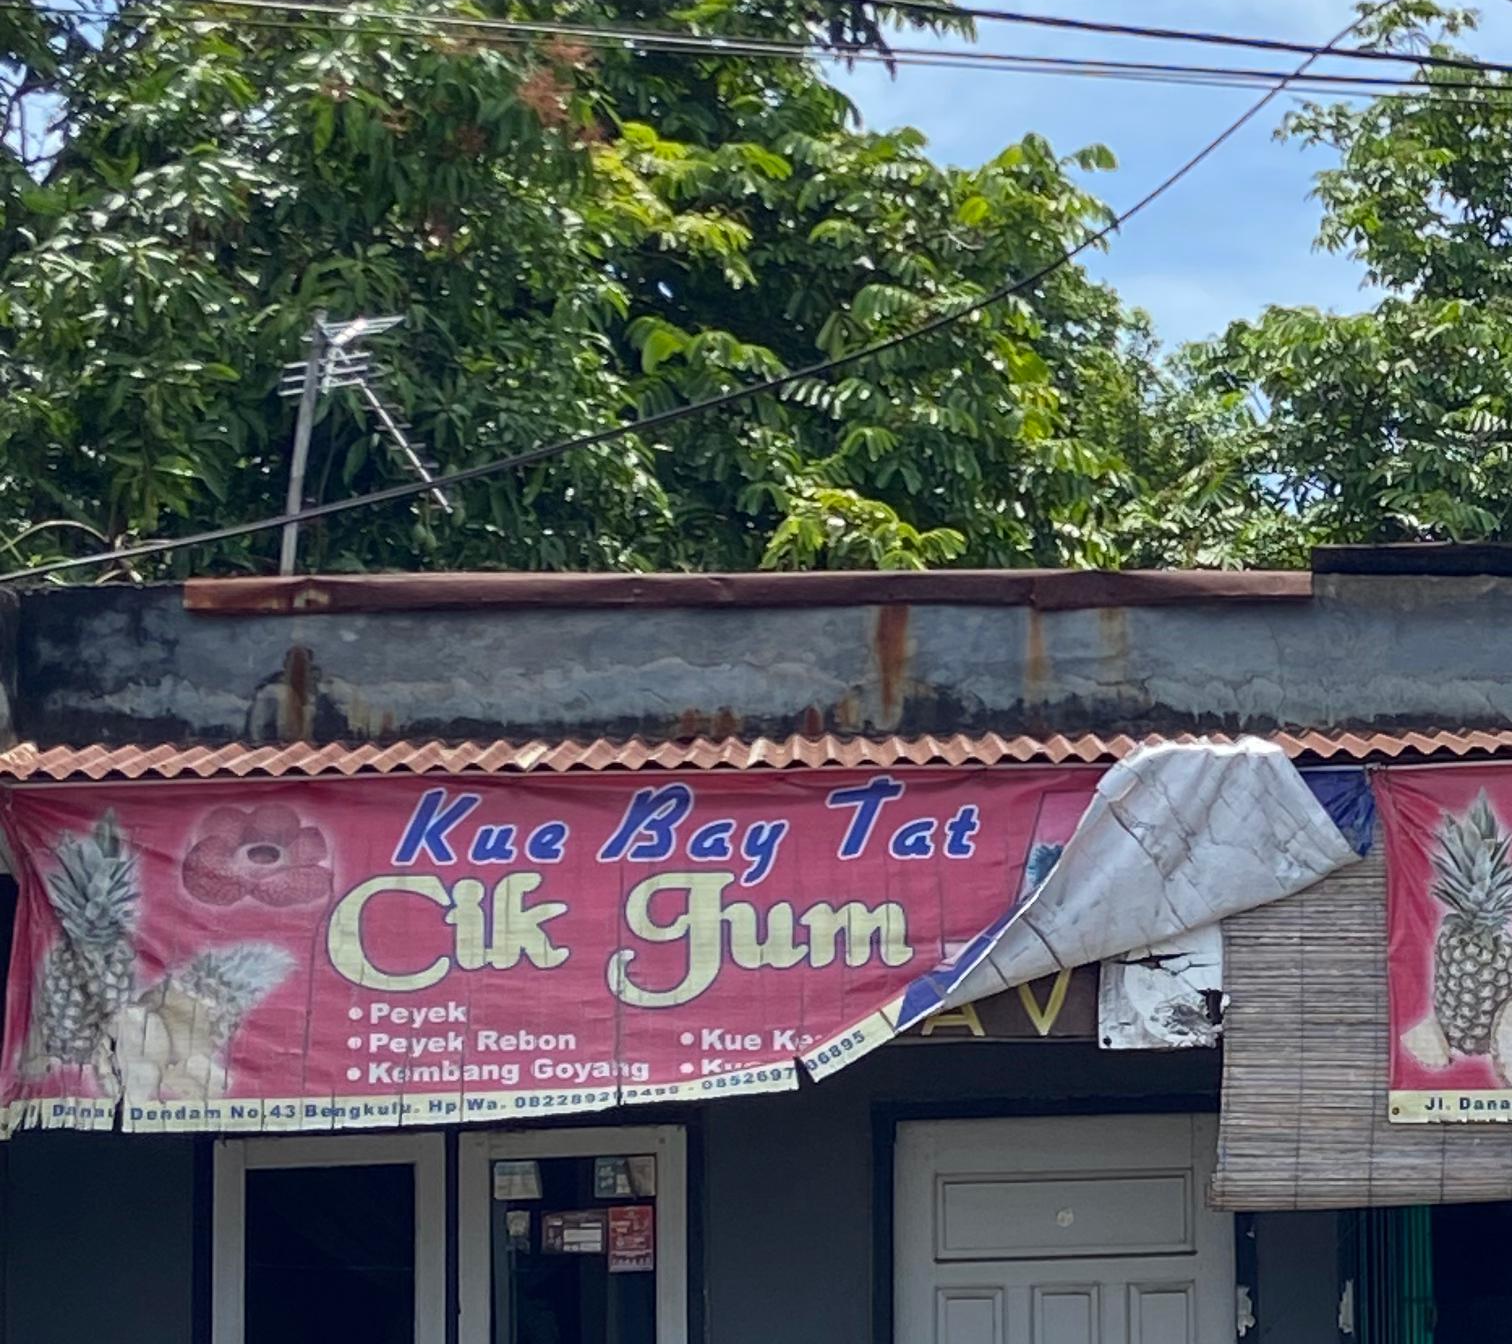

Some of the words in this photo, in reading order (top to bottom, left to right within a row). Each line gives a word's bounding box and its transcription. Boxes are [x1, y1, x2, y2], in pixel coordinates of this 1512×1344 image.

[393, 787, 569, 867] Kue
[597, 782, 790, 886] Bay
[826, 775, 980, 859] Tat
[327, 873, 570, 992] Cik
[370, 1002, 467, 1028] Peyek
[369, 1032, 463, 1057] Peyek
[477, 1030, 576, 1051] Rebon
[701, 1028, 762, 1051] Kue
[368, 1061, 520, 1084] Kembang
[531, 1058, 649, 1082] Goyang
[130, 1105, 221, 1121] Dendam
